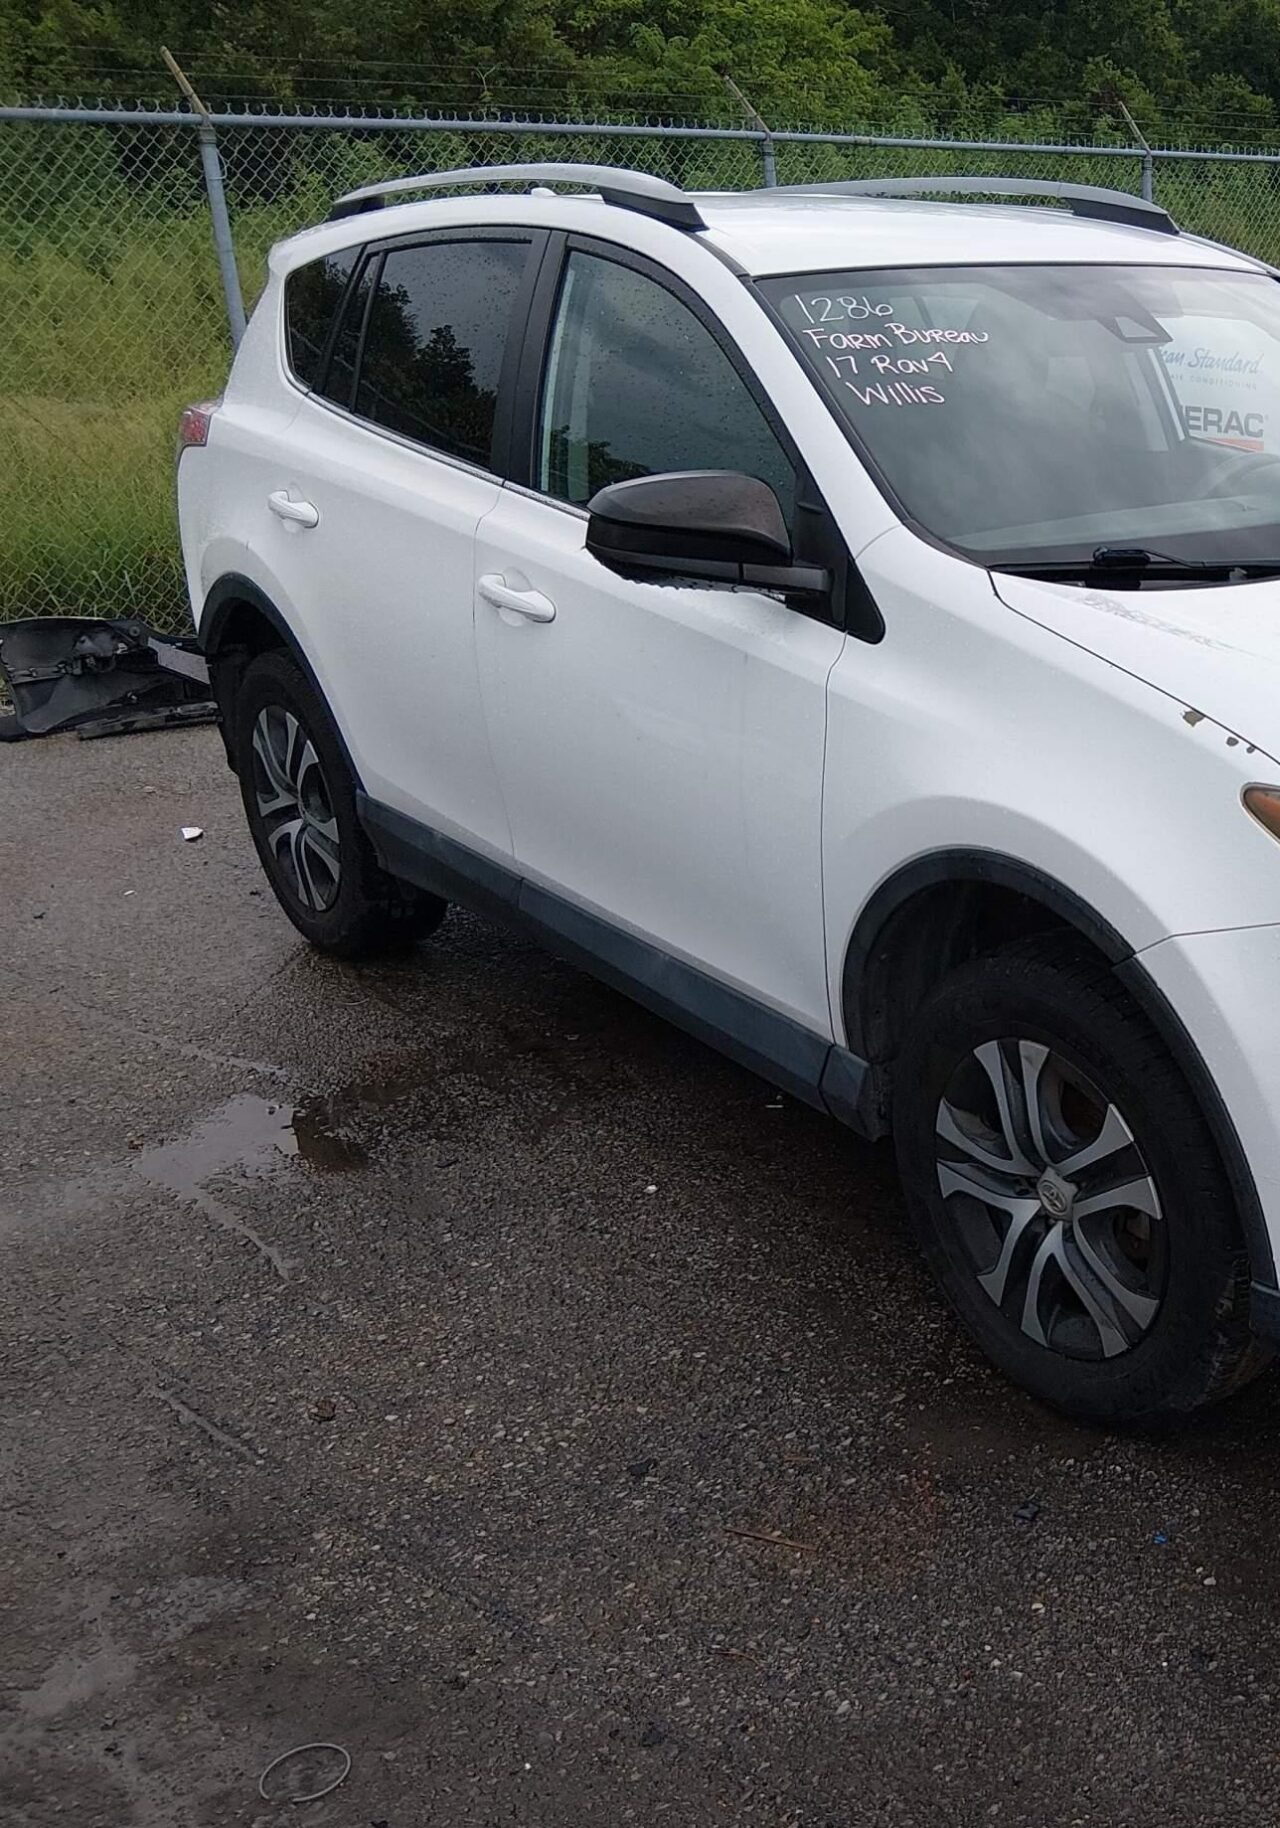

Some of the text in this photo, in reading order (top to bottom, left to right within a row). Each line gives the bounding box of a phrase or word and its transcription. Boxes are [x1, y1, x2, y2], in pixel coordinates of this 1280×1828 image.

[794, 294, 893, 324] 1286
[825, 351, 954, 379] 17 Rav4
[1187, 347, 1264, 375] Standard
[845, 381, 945, 406] Willis
[1181, 404, 1265, 439] ERAC
